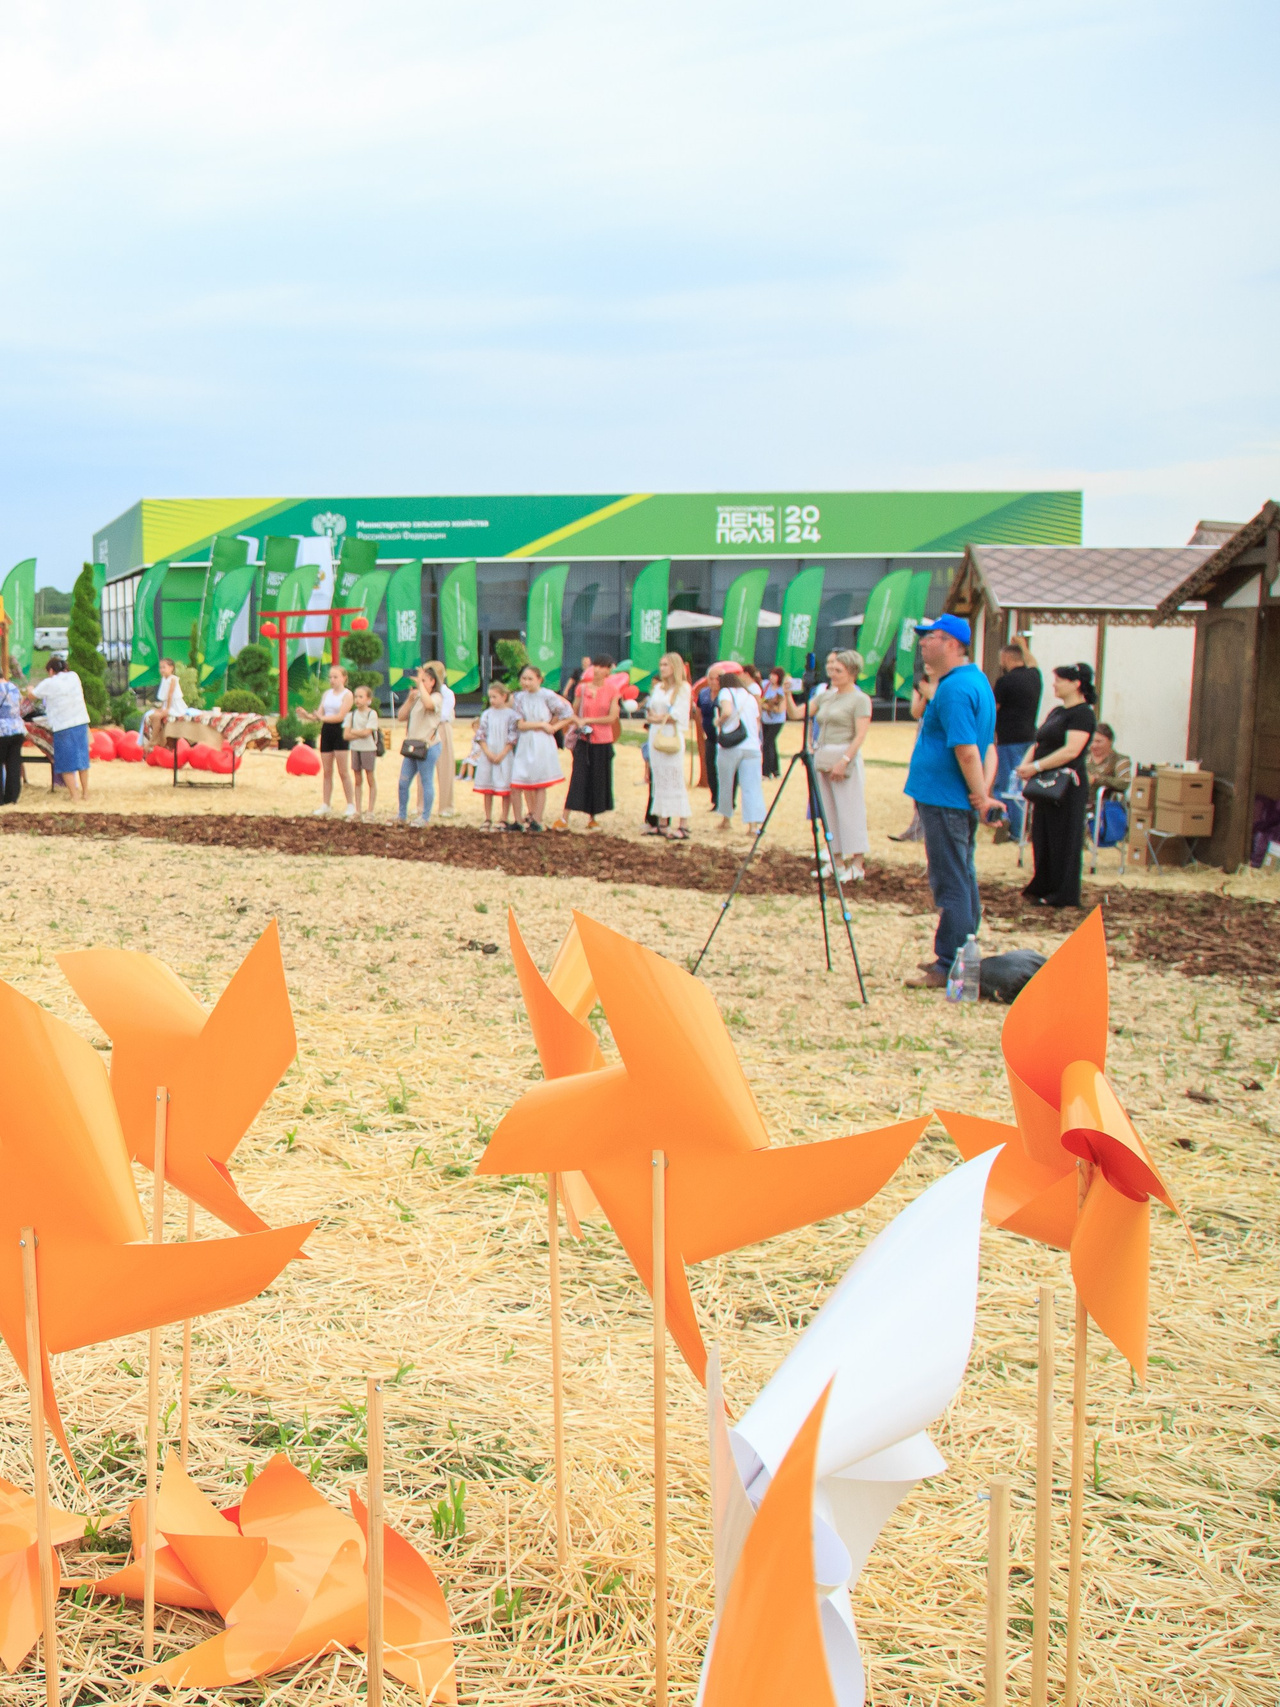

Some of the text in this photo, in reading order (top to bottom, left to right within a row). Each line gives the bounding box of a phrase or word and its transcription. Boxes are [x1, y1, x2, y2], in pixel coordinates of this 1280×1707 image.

[716, 512, 776, 528] ДЕНЬ
[785, 504, 820, 525] 20
[716, 527, 775, 544] ПОЛЯ
[785, 524, 822, 544] 24
